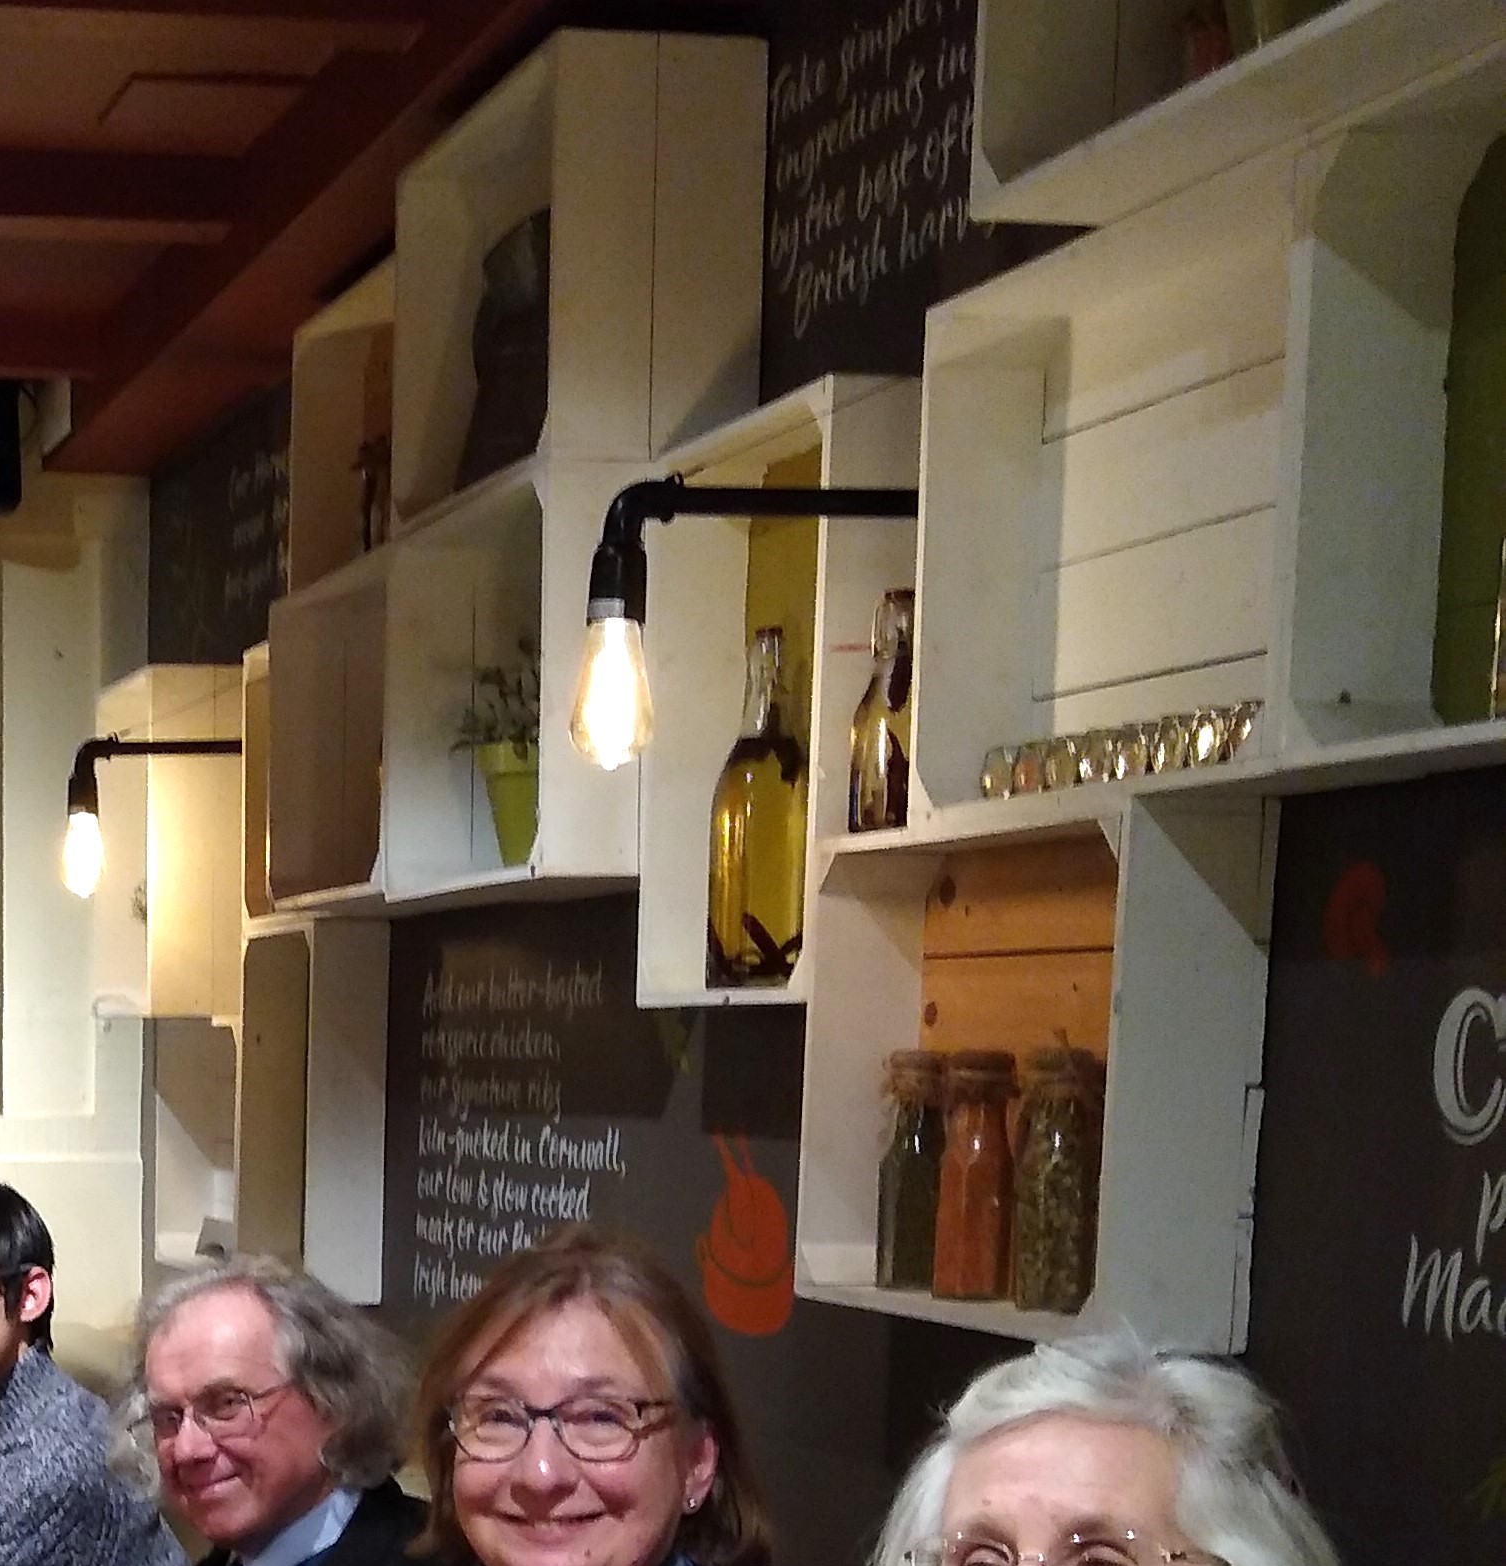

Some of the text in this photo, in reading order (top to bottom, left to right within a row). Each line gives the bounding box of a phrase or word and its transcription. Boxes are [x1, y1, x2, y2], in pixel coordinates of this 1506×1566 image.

[775, 58, 925, 197] ingredients
[770, 207, 799, 294] by
[805, 182, 846, 246] the
[857, 136, 918, 221] best
[923, 102, 958, 193] of
[795, 213, 888, 338] British
[417, 1164, 590, 1223] our low & slow cooked
[513, 1122, 532, 1164] in
[538, 1124, 626, 1181] Cornwall,
[477, 1224, 508, 1256] our
